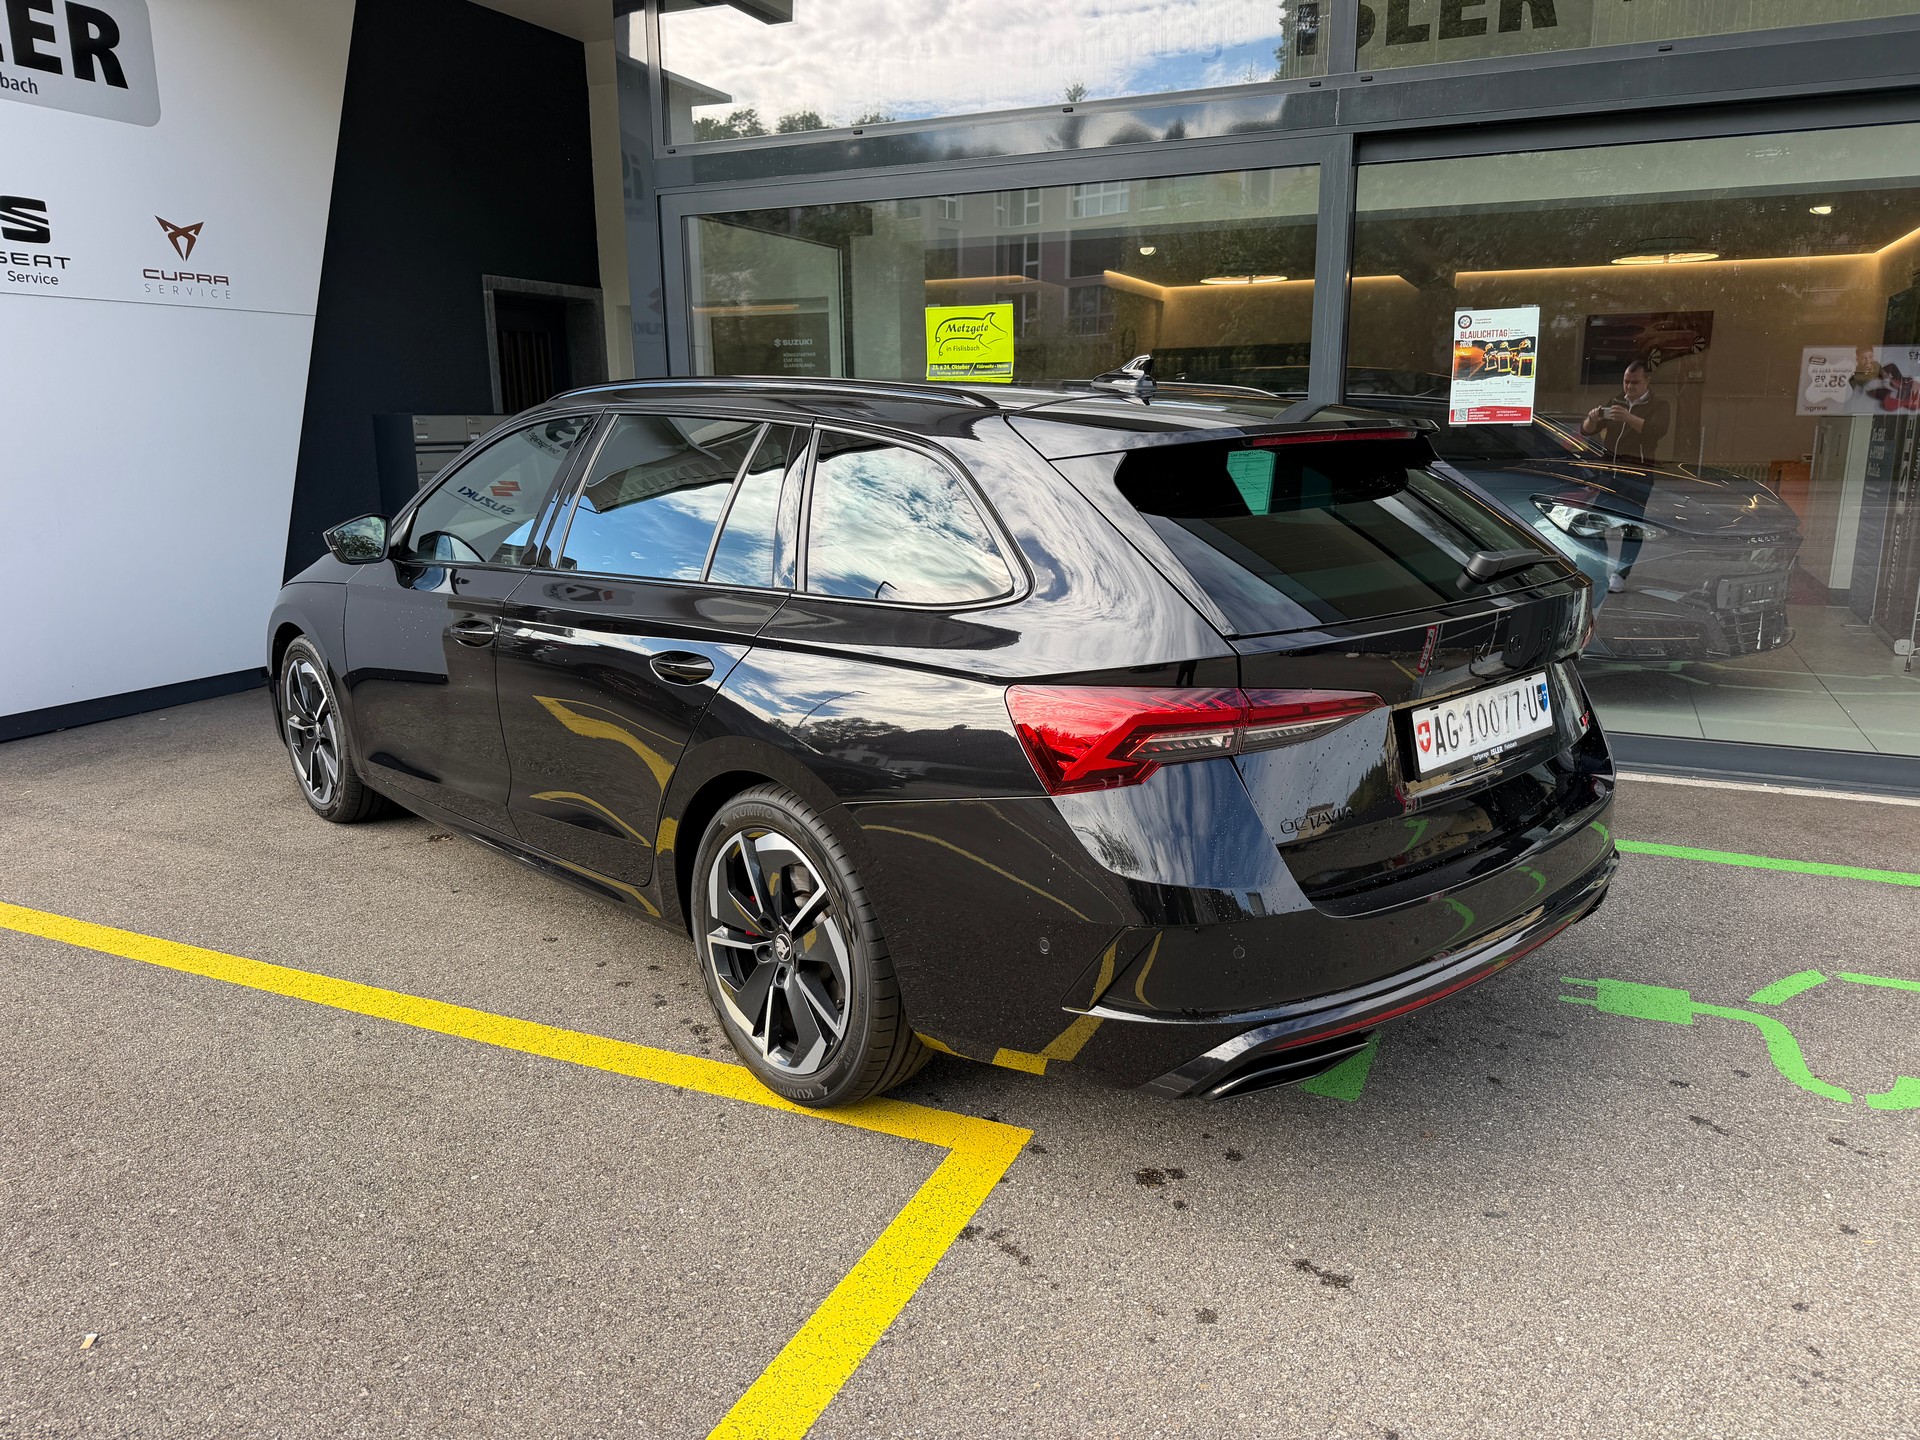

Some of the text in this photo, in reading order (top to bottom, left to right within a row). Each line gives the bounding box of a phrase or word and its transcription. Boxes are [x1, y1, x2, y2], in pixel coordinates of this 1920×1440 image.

[0, 0, 129, 89] ER
[7, 271, 59, 285] Service
[143, 269, 230, 286] CUPRA
[145, 284, 231, 299] SERVICE
[945, 323, 989, 335] Metzgete
[1460, 328, 1508, 340] BLAULICHTTAG
[1490, 746, 1504, 756] ISLER
[732, 805, 774, 820] KUMHO
[1280, 806, 1355, 834] OCTAVIA
